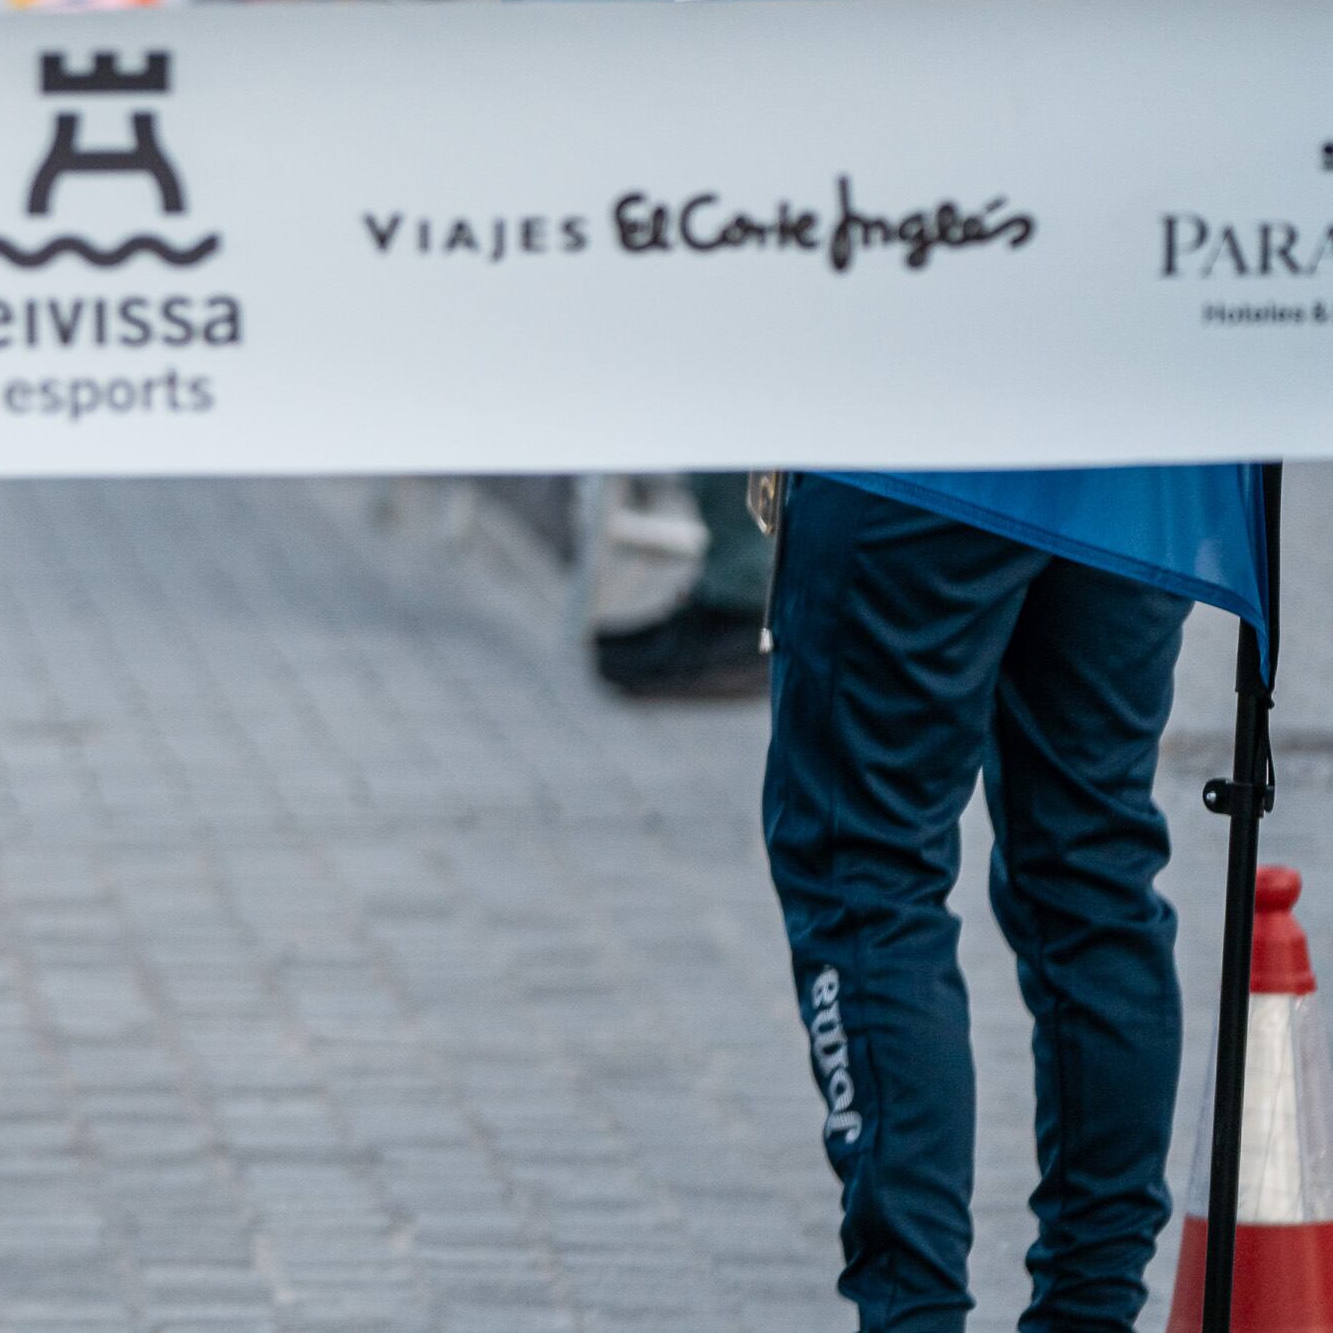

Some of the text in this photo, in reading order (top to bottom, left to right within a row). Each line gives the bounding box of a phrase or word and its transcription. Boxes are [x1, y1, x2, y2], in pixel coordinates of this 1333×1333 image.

[361, 174, 1037, 276] VIAJES El Corte Inglés
[1202, 300, 1306, 327] Hoteles
[1, 365, 216, 423] esports
